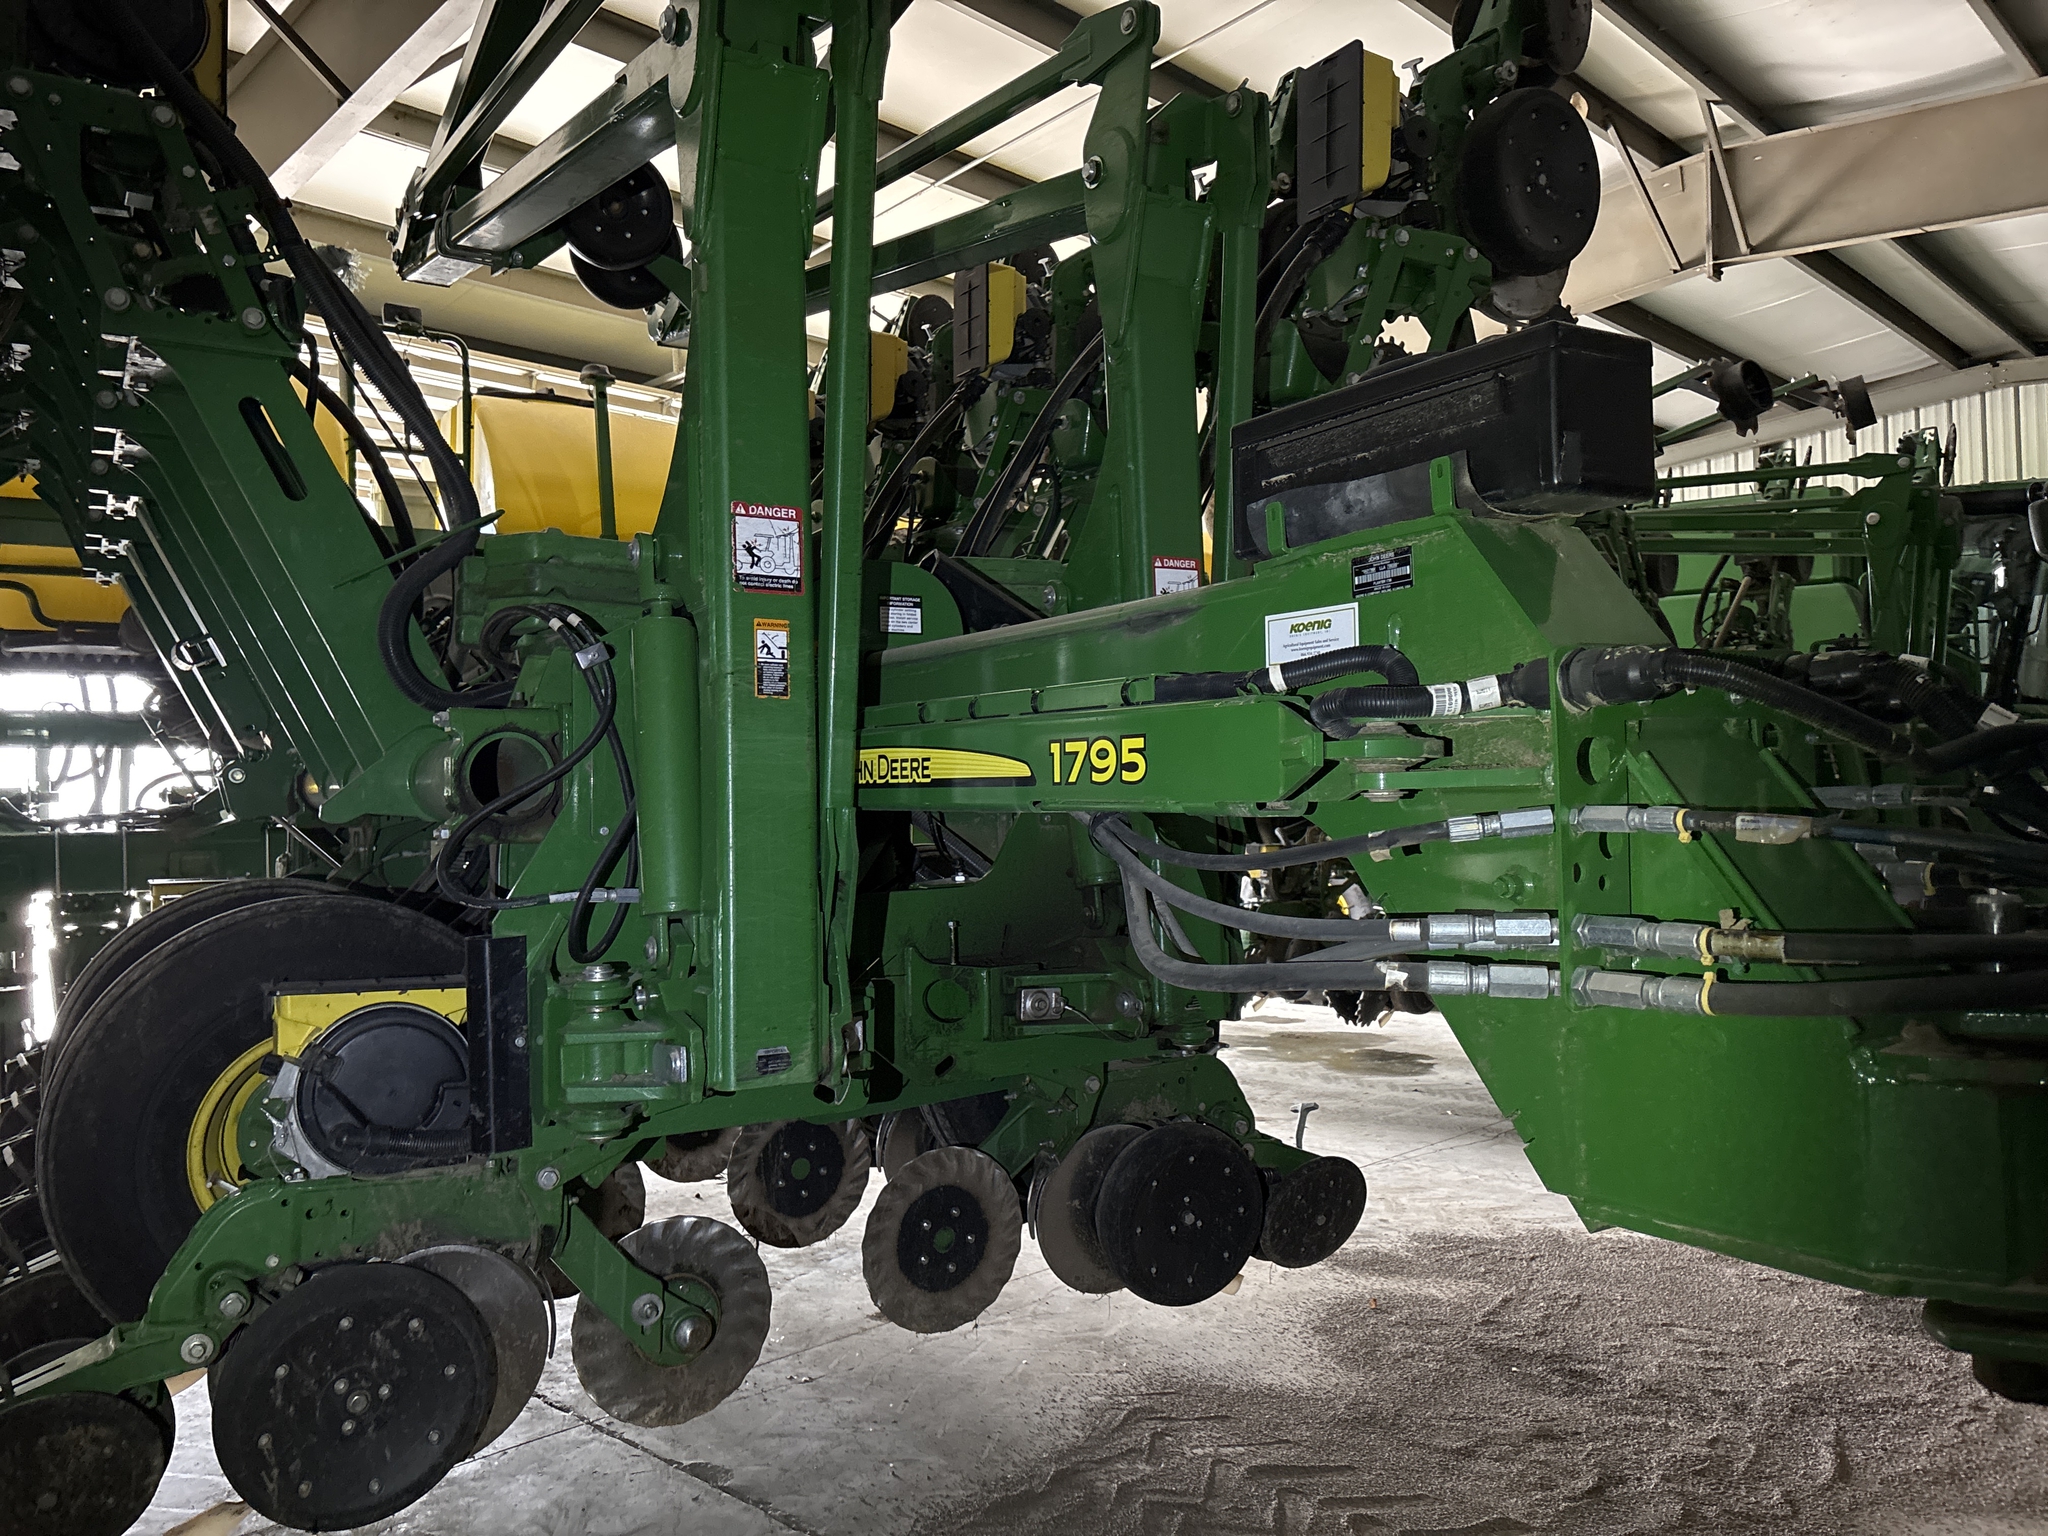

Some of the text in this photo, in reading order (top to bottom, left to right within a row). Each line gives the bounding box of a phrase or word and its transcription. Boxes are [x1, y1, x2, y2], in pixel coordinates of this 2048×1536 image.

[748, 505, 796, 519] DANGER
[1163, 558, 1196, 569] DANGER
[877, 754, 932, 783] DEERE
[1049, 733, 1148, 786] 1795
